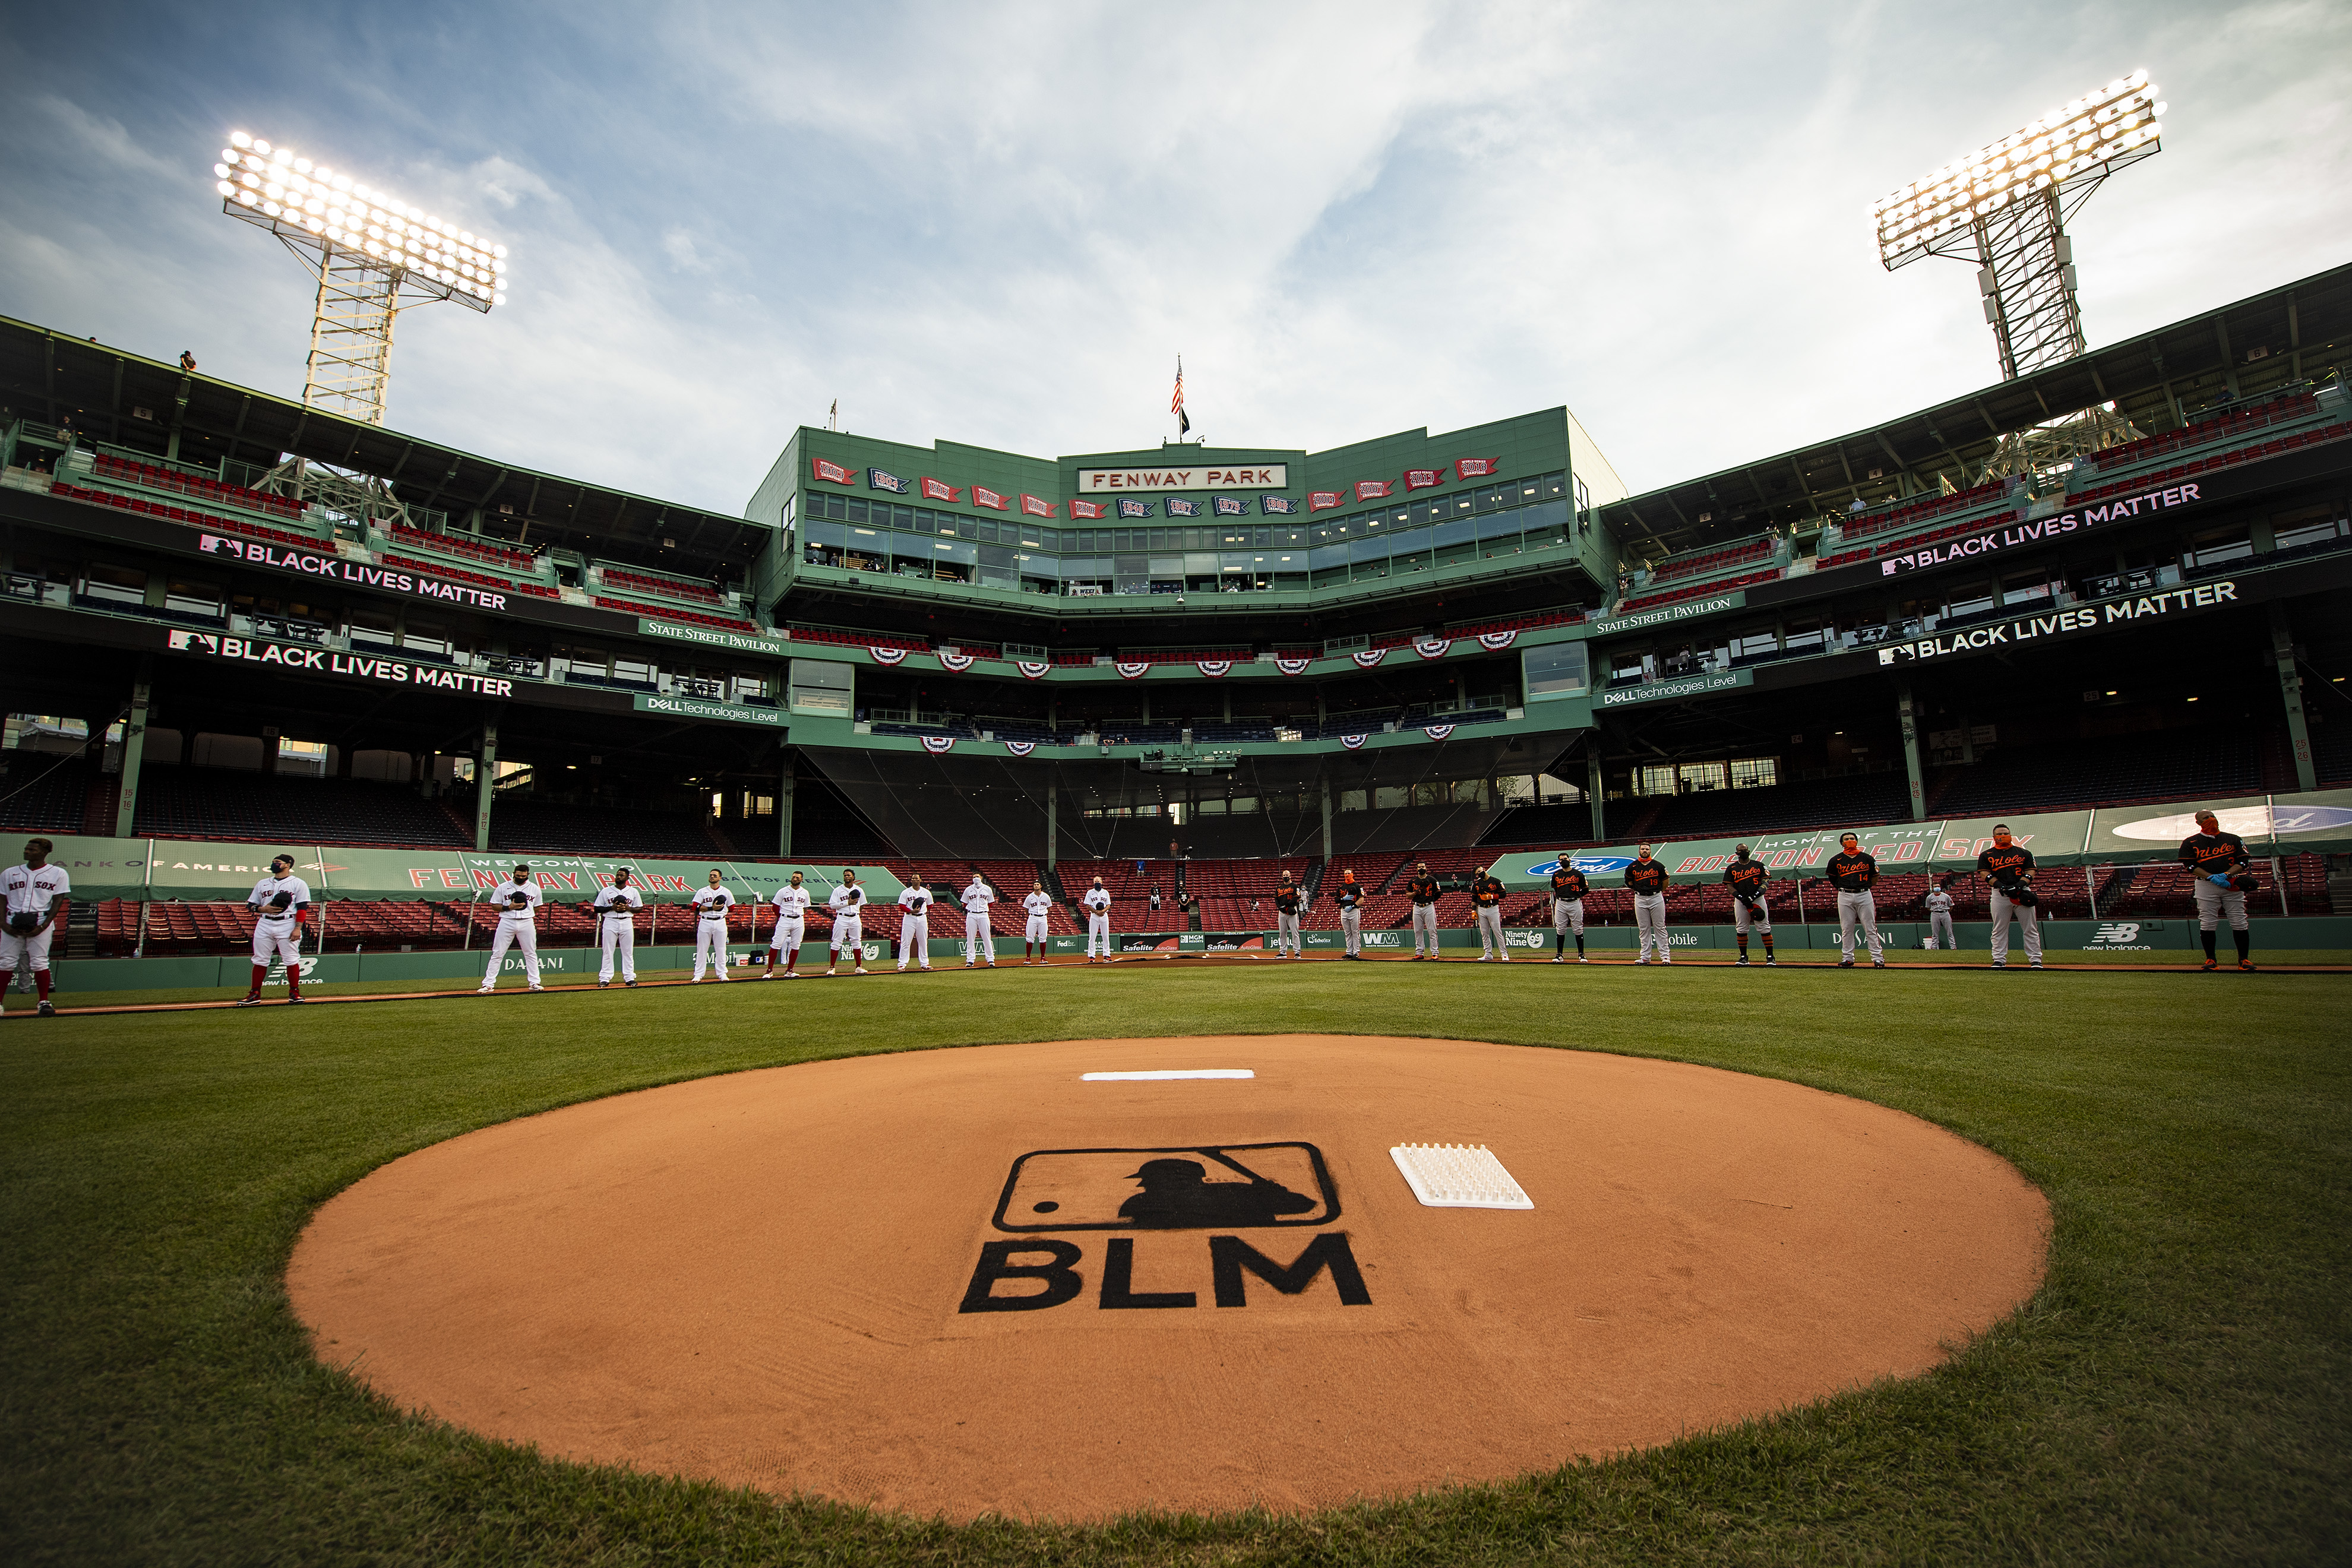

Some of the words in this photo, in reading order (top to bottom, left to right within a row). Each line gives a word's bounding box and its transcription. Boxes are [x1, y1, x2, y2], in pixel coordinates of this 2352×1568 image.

[820, 464, 845, 479] 1903
[1461, 463, 1487, 473] 2018
[874, 474, 899, 488] 1904
[1093, 472, 1190, 488] FENWAY
[1207, 469, 1272, 484] PARK
[1409, 474, 1434, 484] 2013
[929, 483, 949, 497] 1912
[1360, 485, 1384, 495] 2007
[979, 491, 998, 505] 1915
[1266, 499, 1288, 510] 1986
[1313, 495, 1335, 505] 2004
[1028, 499, 1047, 512] 1916
[1076, 504, 1095, 514] 1918
[1123, 503, 1144, 513] 1946
[1171, 502, 1192, 512] 1967
[1219, 500, 1240, 511] 1975
[1918, 533, 1998, 567] BLACK
[2004, 514, 2078, 545] LIVES
[2085, 483, 2201, 526] MATTER
[246, 543, 337, 577] BLACK
[344, 564, 412, 591] LIVES
[419, 579, 506, 610] MATTER
[1597, 620, 1629, 633] STATE
[1630, 611, 1670, 627] STREET
[1674, 598, 1731, 618] PAVILION
[1918, 625, 2008, 658] BLACK
[2013, 609, 2097, 639] LIVES
[2104, 581, 2239, 623] MATTER
[649, 622, 683, 637] STATE
[685, 629, 725, 644] STREET
[729, 635, 780, 653] PAVILION
[222, 637, 325, 669] BLACK
[332, 655, 409, 681] LIVES
[415, 667, 513, 697] MATTER
[1635, 681, 1704, 700] Technologies
[1707, 674, 1737, 688] Level
[2086, 692, 2097, 700] 25
[682, 702, 750, 720] Technologies
[752, 710, 777, 722] Level
[267, 727, 275, 735] 16
[2296, 739, 2306, 748] 25
[2297, 751, 2308, 760] 26
[1766, 835, 1835, 848] HOME
[1890, 829, 1940, 838] THE
[1988, 854, 2025, 871] Orioles
[1632, 868, 1658, 881] Orioles
[1732, 867, 1760, 883] Orioles
[1836, 862, 1869, 877] Orioles
[8, 881, 25, 891] RED
[34, 881, 56, 891] SOX
[1555, 875, 1579, 887] Orioles
[1363, 933, 1399, 944] WM
[1506, 931, 1527, 939] Ninety
[1506, 938, 1526, 946] Nine
[505, 957, 562, 971] DAANI
[282, 977, 323, 985] bance
[958, 1232, 1373, 1314] BLM
